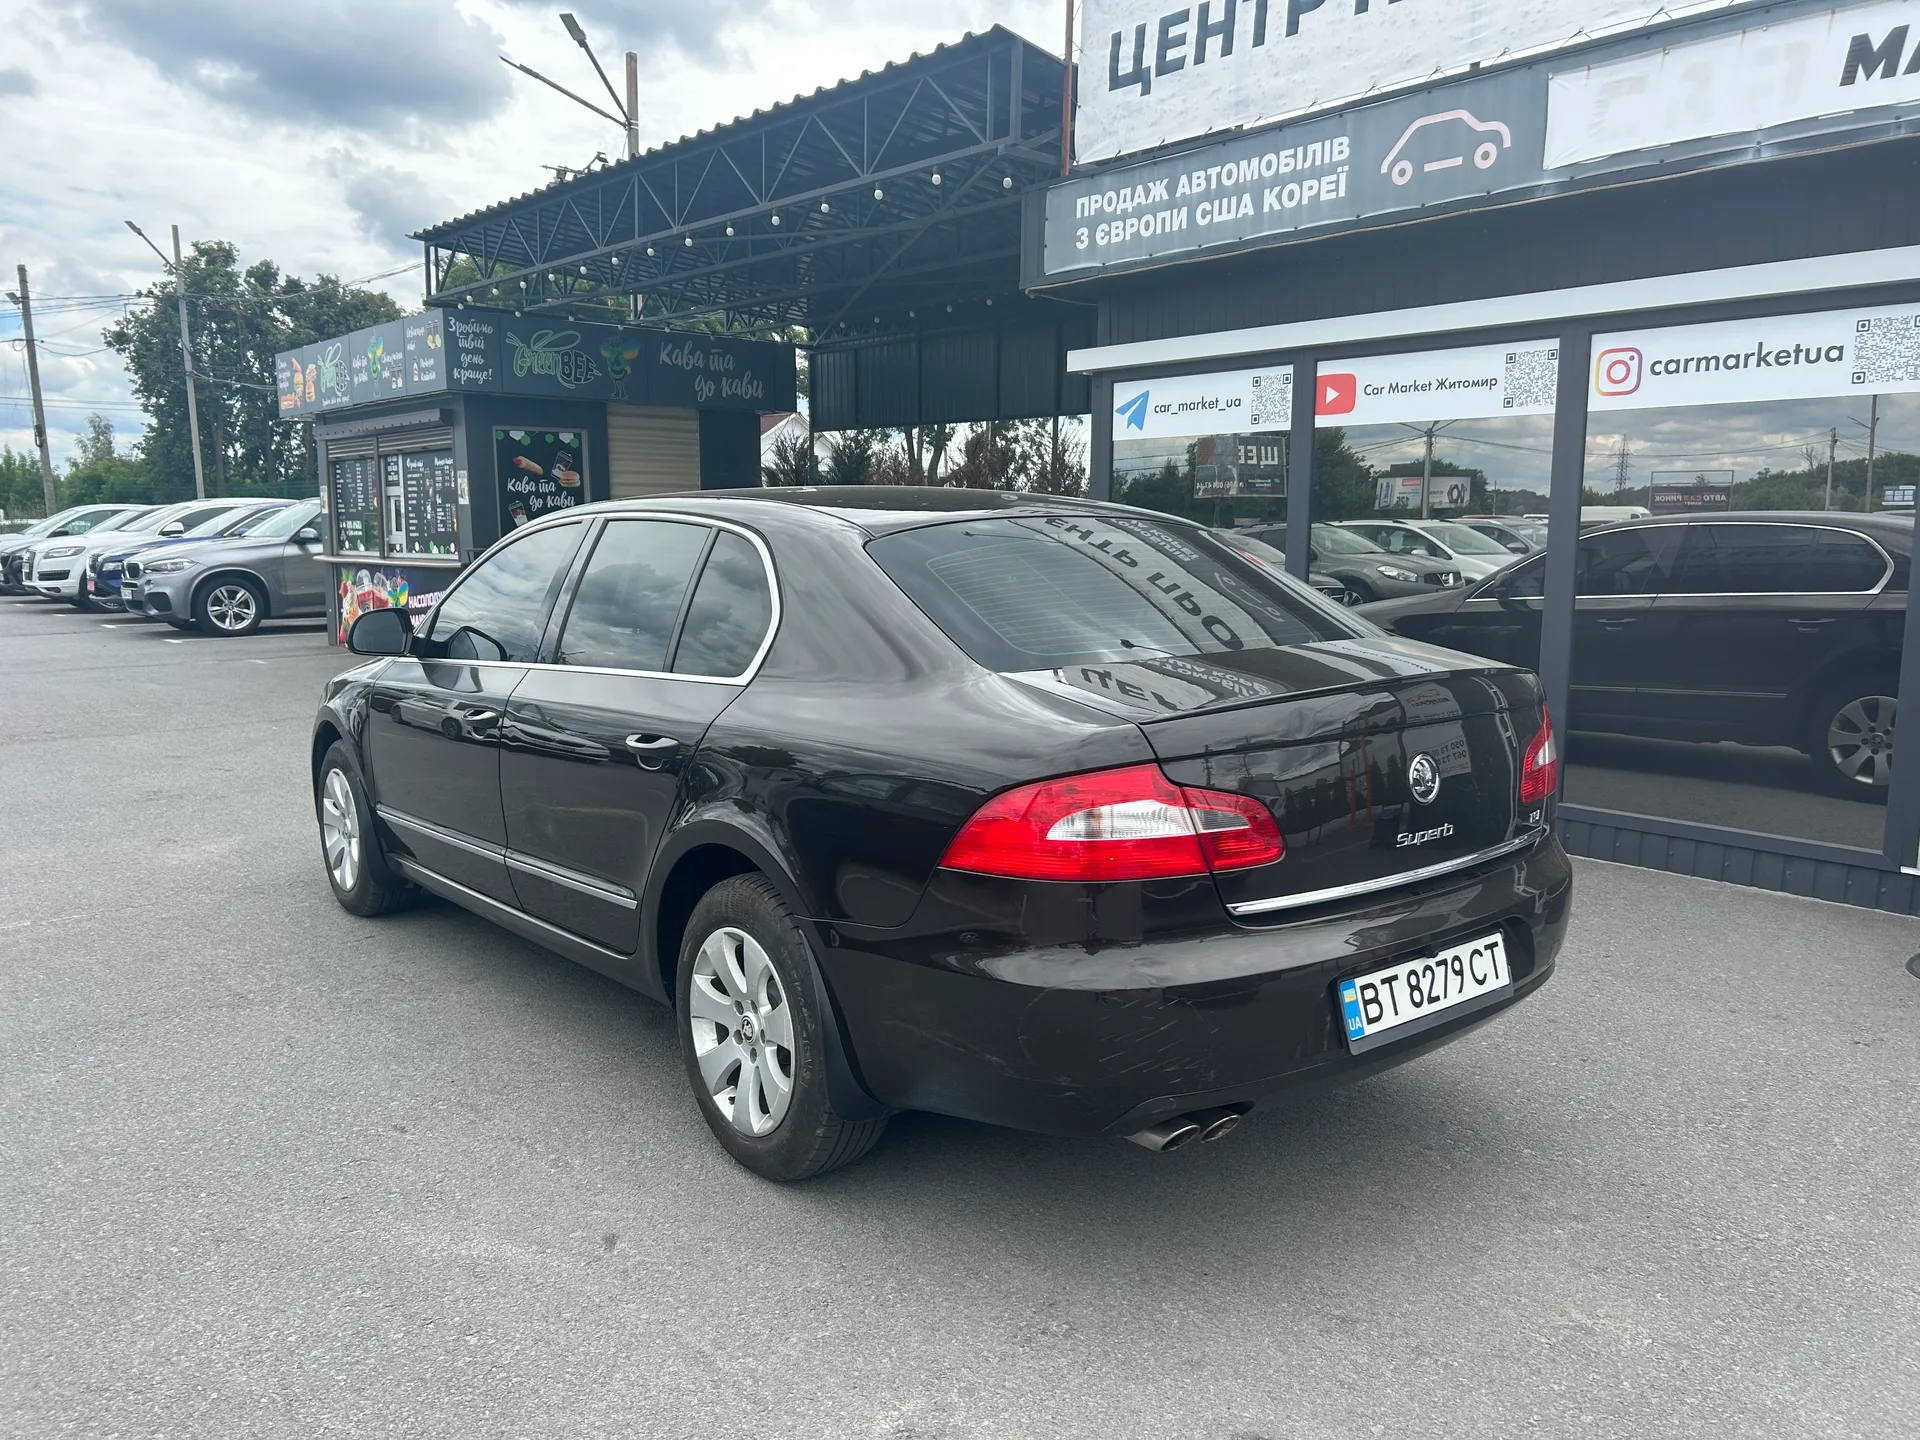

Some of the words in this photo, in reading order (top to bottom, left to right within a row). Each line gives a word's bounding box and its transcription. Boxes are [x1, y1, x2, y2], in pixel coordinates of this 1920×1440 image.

[1108, 0, 1326, 96] ЦЕНТР
[1076, 178, 1169, 218] ПРОДАЖ
[1175, 136, 1350, 197] АВТОМОБІЛІВ
[1076, 227, 1089, 249] З
[1096, 206, 1187, 246] ЄВРОПИ
[1195, 193, 1254, 226] США
[1263, 165, 1350, 212] КОРЕЇ
[448, 316, 493, 337] Зробимо
[458, 334, 485, 349] твій
[460, 353, 485, 368] день
[660, 341, 705, 370] Кава
[709, 349, 736, 372] та
[1650, 341, 1844, 376] carmarketua
[452, 367, 493, 385] краще!
[694, 375, 716, 402] до
[720, 370, 764, 399] кави
[1363, 384, 1385, 396] Car
[1388, 379, 1432, 394] Market
[1435, 377, 1498, 391] Житомир
[1153, 396, 1241, 415] car_market_ua
[507, 476, 537, 493] Кава
[539, 479, 556, 493] та
[529, 495, 543, 511] до
[546, 491, 575, 508] кави
[1396, 823, 1453, 847] Superb
[1359, 974, 1399, 1025] BT
[1406, 955, 1464, 1009] 8279
[1469, 941, 1499, 986] CT
[1348, 1018, 1362, 1031] UA
